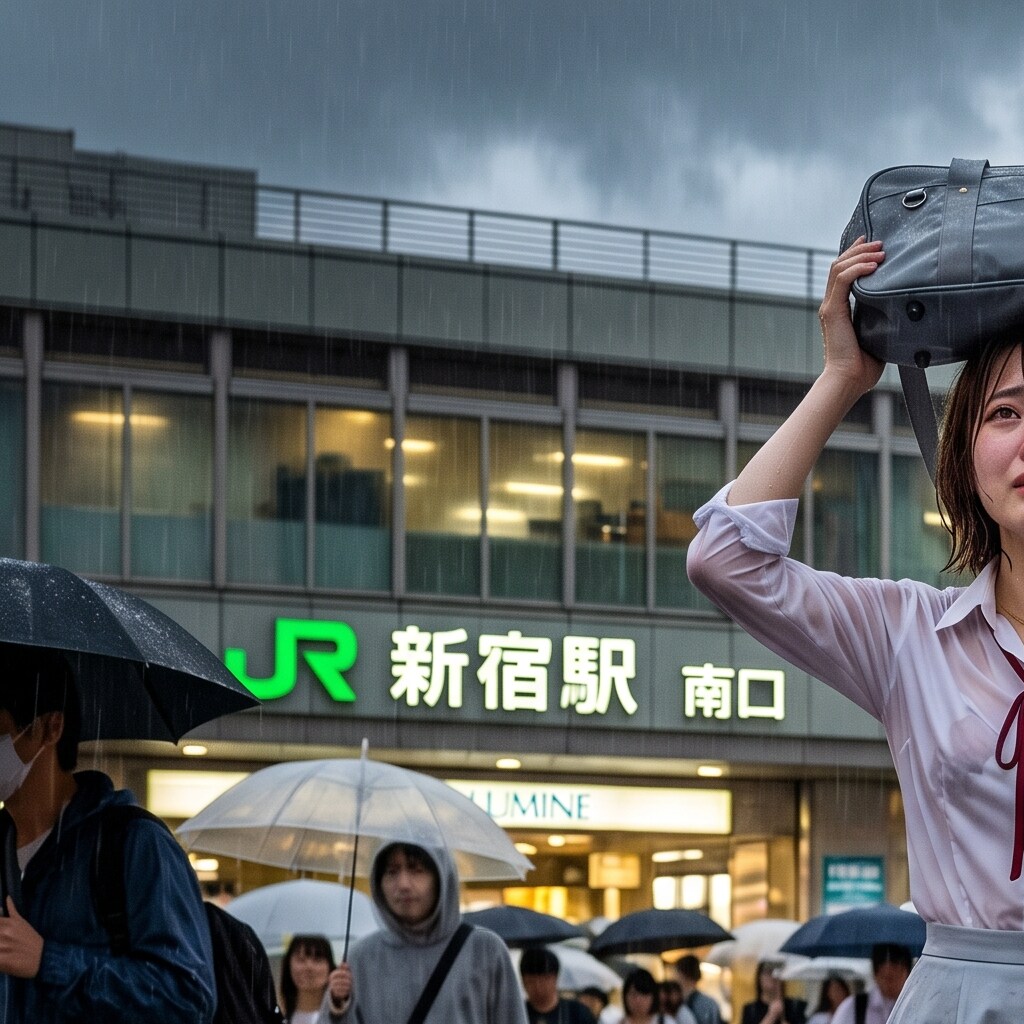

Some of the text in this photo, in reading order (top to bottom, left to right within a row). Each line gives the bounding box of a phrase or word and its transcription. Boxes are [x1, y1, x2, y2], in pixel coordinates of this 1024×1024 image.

[225, 617, 786, 721] JR 新宿駅 南口
